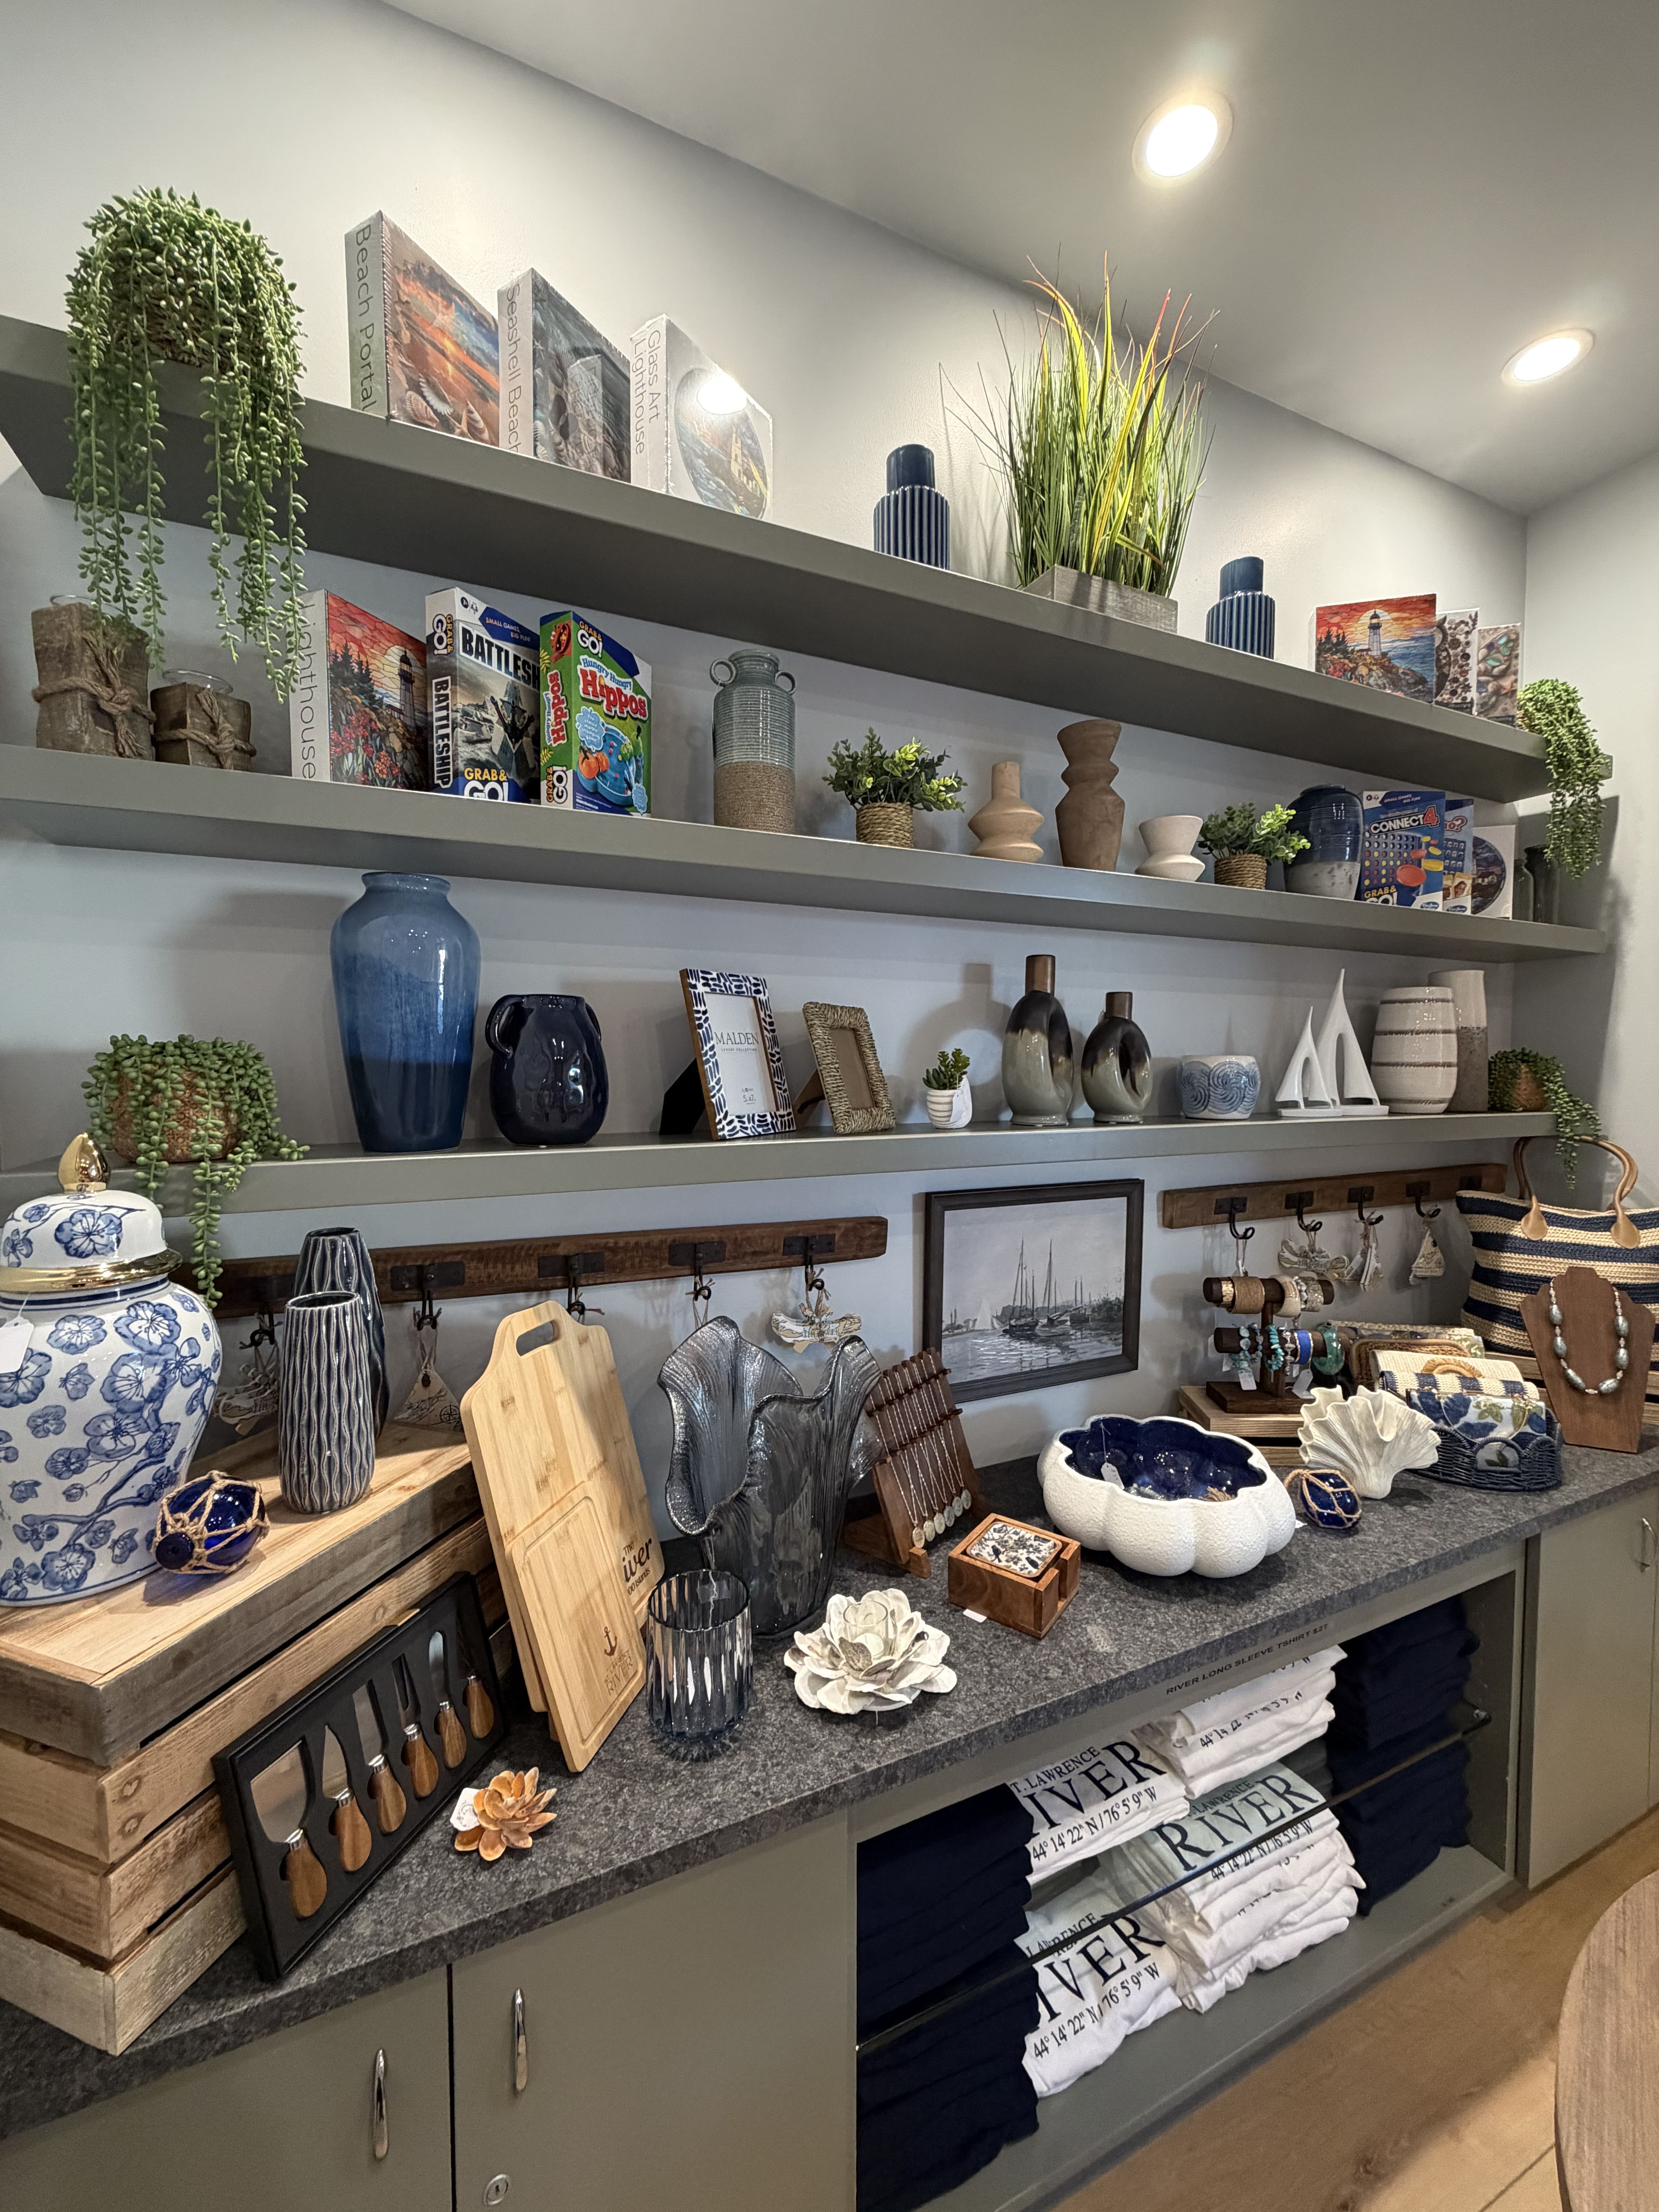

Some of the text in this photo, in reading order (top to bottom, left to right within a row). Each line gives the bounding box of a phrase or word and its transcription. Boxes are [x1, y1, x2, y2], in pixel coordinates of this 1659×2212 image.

[356, 224, 377, 411] Beach Portal
[507, 283, 521, 453] Seashell Beach
[648, 330, 661, 423] Glass Art
[632, 338, 647, 455] Lighthouse
[433, 614, 448, 655] GO!
[486, 617, 503, 627] SMALL
[577, 629, 603, 658] GO!
[461, 626, 540, 688] BATTLESH
[582, 658, 632, 690] Hungry Hungry
[548, 672, 568, 744] Hippos
[579, 668, 647, 717] Hippos
[434, 678, 451, 787] BATTLESHIP
[553, 766, 568, 804] GO!
[1370, 814, 1424, 833] CONNECT
[1423, 807, 1438, 825] 4
[714, 1032, 759, 1045] MALDEN
[622, 1538, 652, 1583] iver
[623, 1541, 634, 1556] The
[1166, 1677, 1199, 1695] RIVER
[1202, 1664, 1232, 1680] LONG
[1235, 1647, 1273, 1666] SLEEVE
[1276, 1631, 1311, 1649] TSHIRT
[1024, 1741, 1167, 1838] IVER
[1025, 1746, 1100, 1788] LAWRENCE
[1032, 1841, 1049, 1861] 44°
[1144, 1786, 1157, 1803] W
[1150, 1774, 1319, 1871] RIVER
[1192, 1781, 1255, 1813] LAWRENCE
[1300, 1820, 1313, 1834] W
[1030, 1915, 1166, 2033] IVER
[1033, 2036, 1049, 2059] 44°
[1144, 1962, 1160, 1980] W
